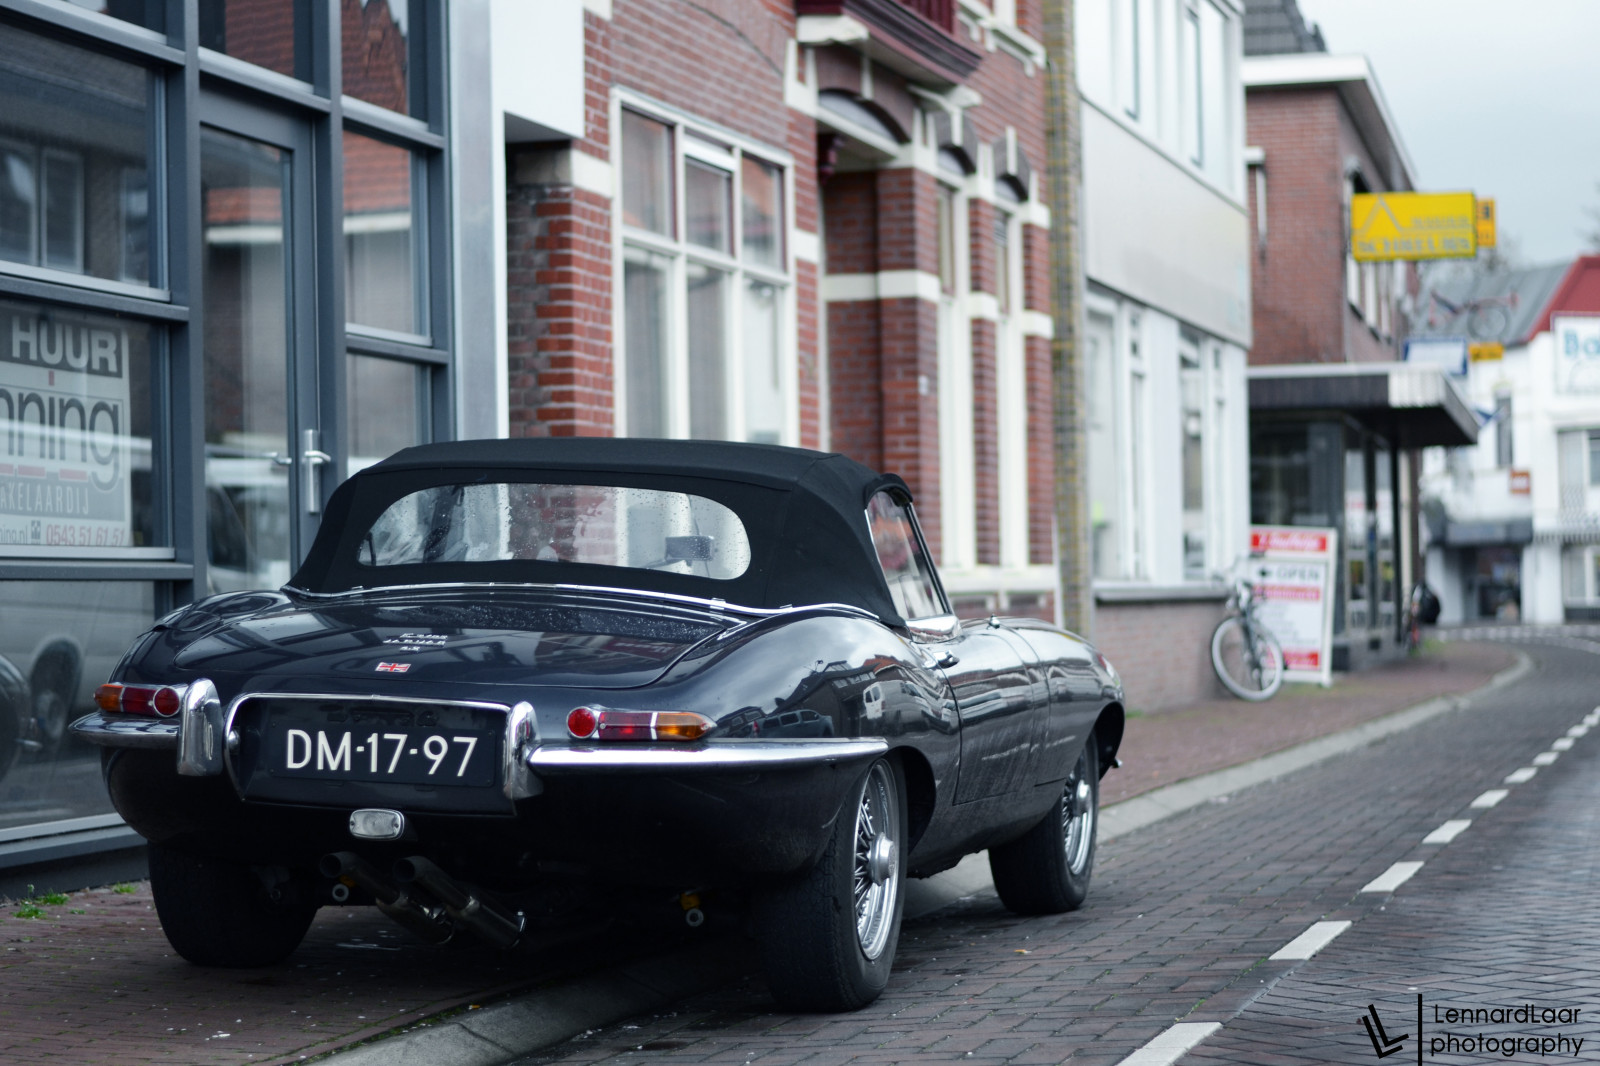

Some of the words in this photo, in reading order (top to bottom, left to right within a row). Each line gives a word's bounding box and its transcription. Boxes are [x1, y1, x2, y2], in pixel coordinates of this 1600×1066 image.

[12, 317, 118, 372] HUUR
[46, 523, 76, 545] 0543
[79, 525, 92, 546] 51
[286, 728, 478, 777] DM-17-97
